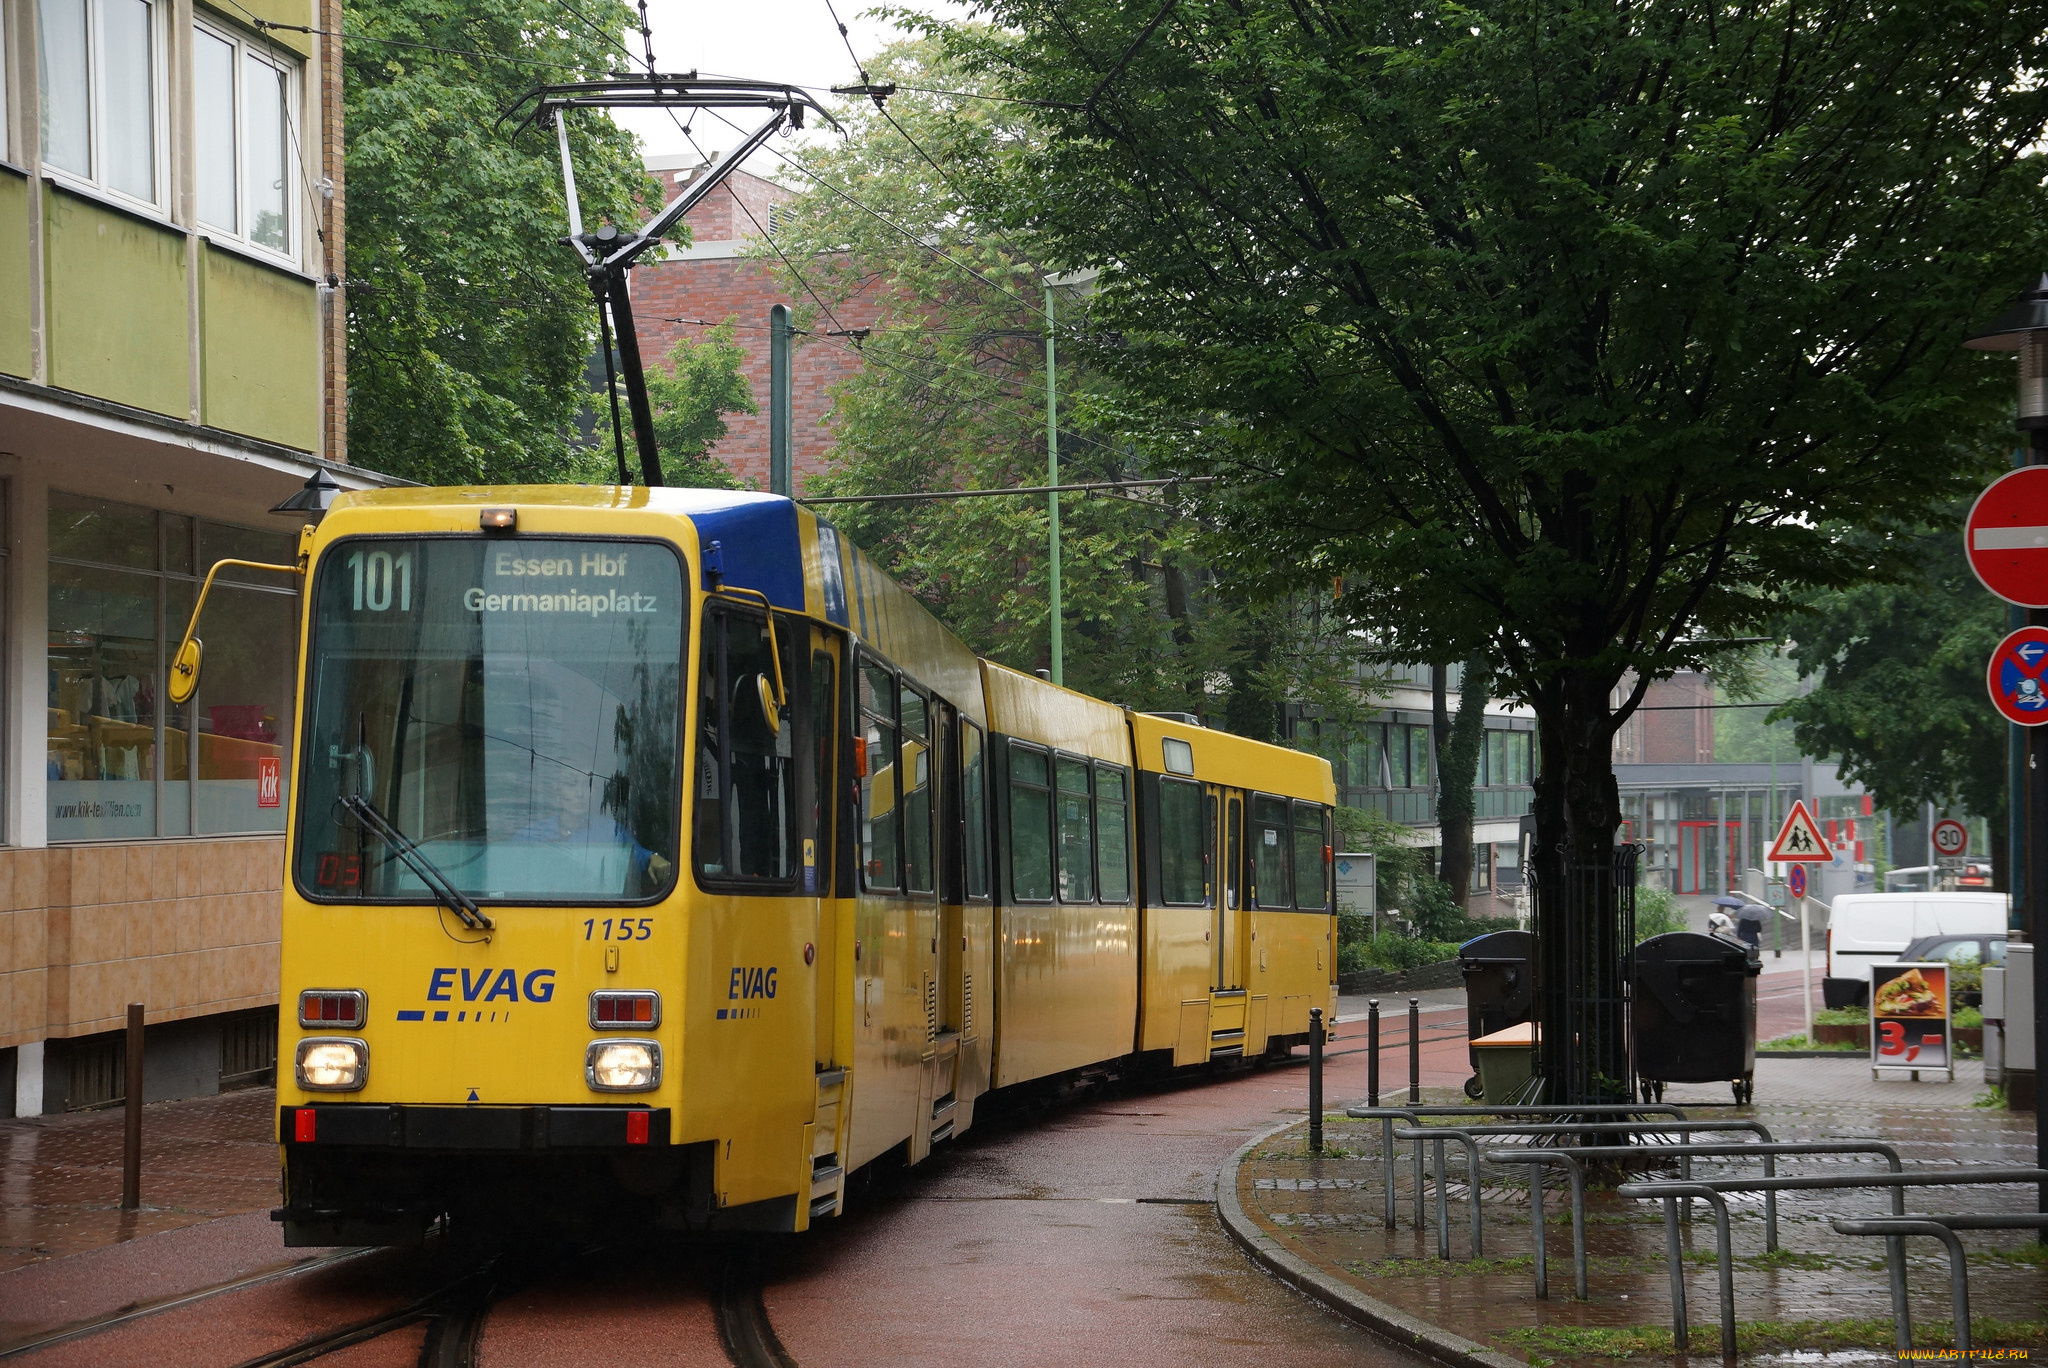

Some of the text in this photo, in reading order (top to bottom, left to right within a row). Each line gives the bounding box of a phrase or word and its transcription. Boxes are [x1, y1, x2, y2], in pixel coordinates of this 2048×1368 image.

[495, 552, 627, 577] Essen Hbf
[347, 551, 412, 611] 101
[463, 587, 658, 618] Germaniaplatz
[1939, 830, 1960, 846] 30
[317, 855, 361, 886] 03
[583, 918, 654, 941] 1155
[426, 967, 556, 1003] EVAG
[728, 966, 778, 1001] EVAG
